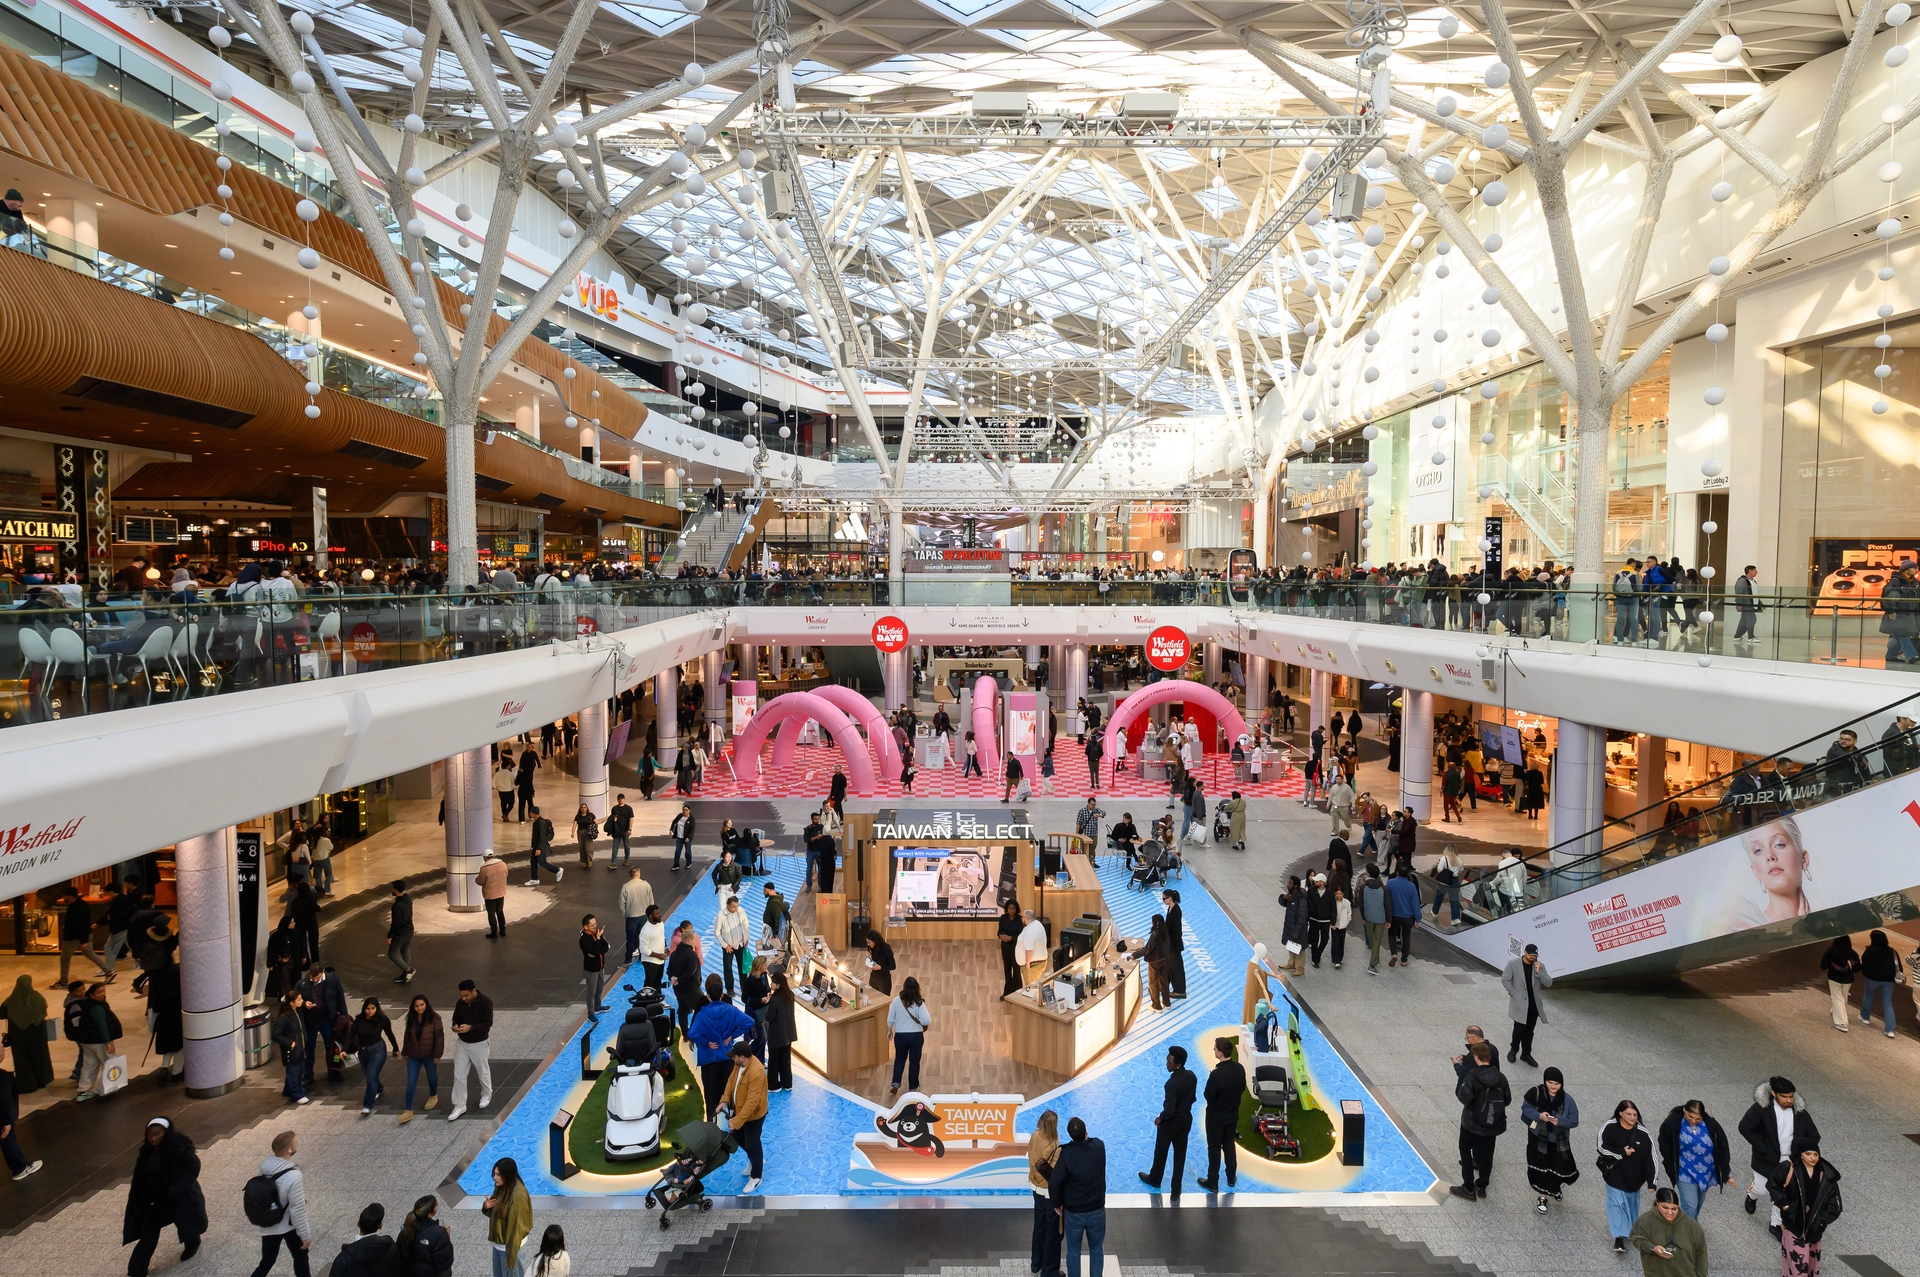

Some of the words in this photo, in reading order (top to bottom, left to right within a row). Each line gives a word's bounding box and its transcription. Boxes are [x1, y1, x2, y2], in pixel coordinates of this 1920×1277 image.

[1416, 471, 1442, 487] OYSHO
[1291, 484, 1327, 508] Abercrombie
[0, 520, 49, 537] ATCH
[51, 523, 75, 538] ME
[1487, 524, 1492, 533] 2
[260, 541, 285, 551] Pho
[914, 551, 943, 560] TAPAS
[943, 550, 1002, 560] REVOLUTION
[1842, 550, 1918, 567] PRO
[805, 616, 828, 624] Westfield
[1133, 615, 1156, 623] Westfield
[877, 625, 904, 635] Westfield
[876, 634, 904, 642] DAYS
[1152, 637, 1185, 648] Westfield
[1151, 648, 1185, 657] DAYS
[1445, 663, 1472, 679] Westfield
[499, 700, 528, 718] Westfield
[0, 815, 87, 858] Westfield
[873, 824, 951, 839] TAIWAN
[960, 824, 1034, 839] SELECT
[40, 849, 62, 865] W12
[249, 845, 257, 857] 8
[1583, 899, 1611, 917] Westfield
[1613, 896, 1627, 909] DAYS
[1588, 914, 1615, 931] EXPERIENCE
[1613, 909, 1632, 926] BEAUTY
[1631, 908, 1638, 919] IN
[1641, 903, 1654, 915] NEW
[1652, 895, 1681, 912] DIMENSION
[1188, 947, 1220, 973] FROM
[944, 1108, 1007, 1121] TAIWAN
[944, 1122, 1005, 1135] SELECT
